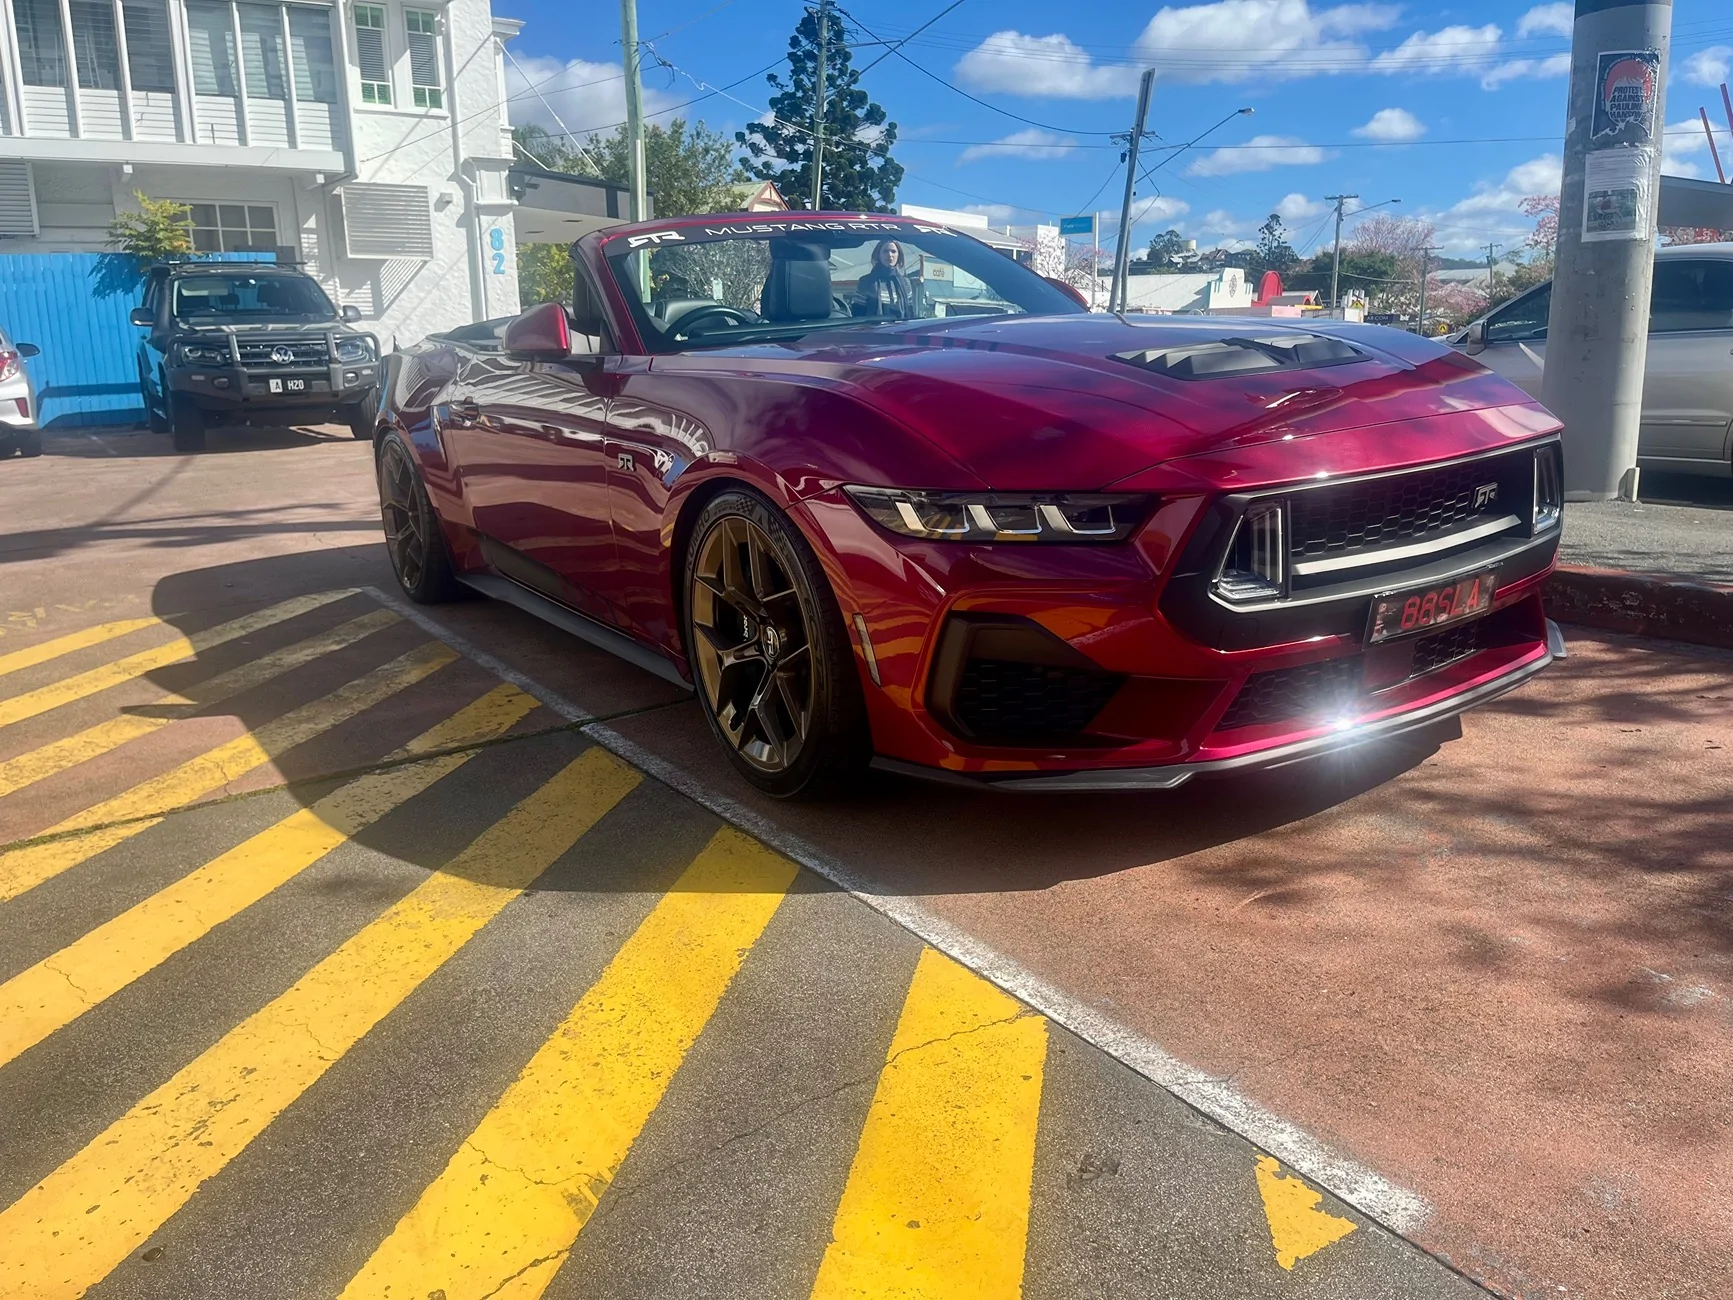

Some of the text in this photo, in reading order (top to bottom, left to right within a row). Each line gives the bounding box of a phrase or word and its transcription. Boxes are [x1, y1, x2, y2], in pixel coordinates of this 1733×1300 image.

[1612, 86, 1643, 95] PROTEST
[1610, 94, 1645, 103] AGAINST
[1610, 102, 1643, 111] PAULINE
[704, 222, 902, 236] MUSTANG RTR
[687, 509, 711, 572] KUMHO
